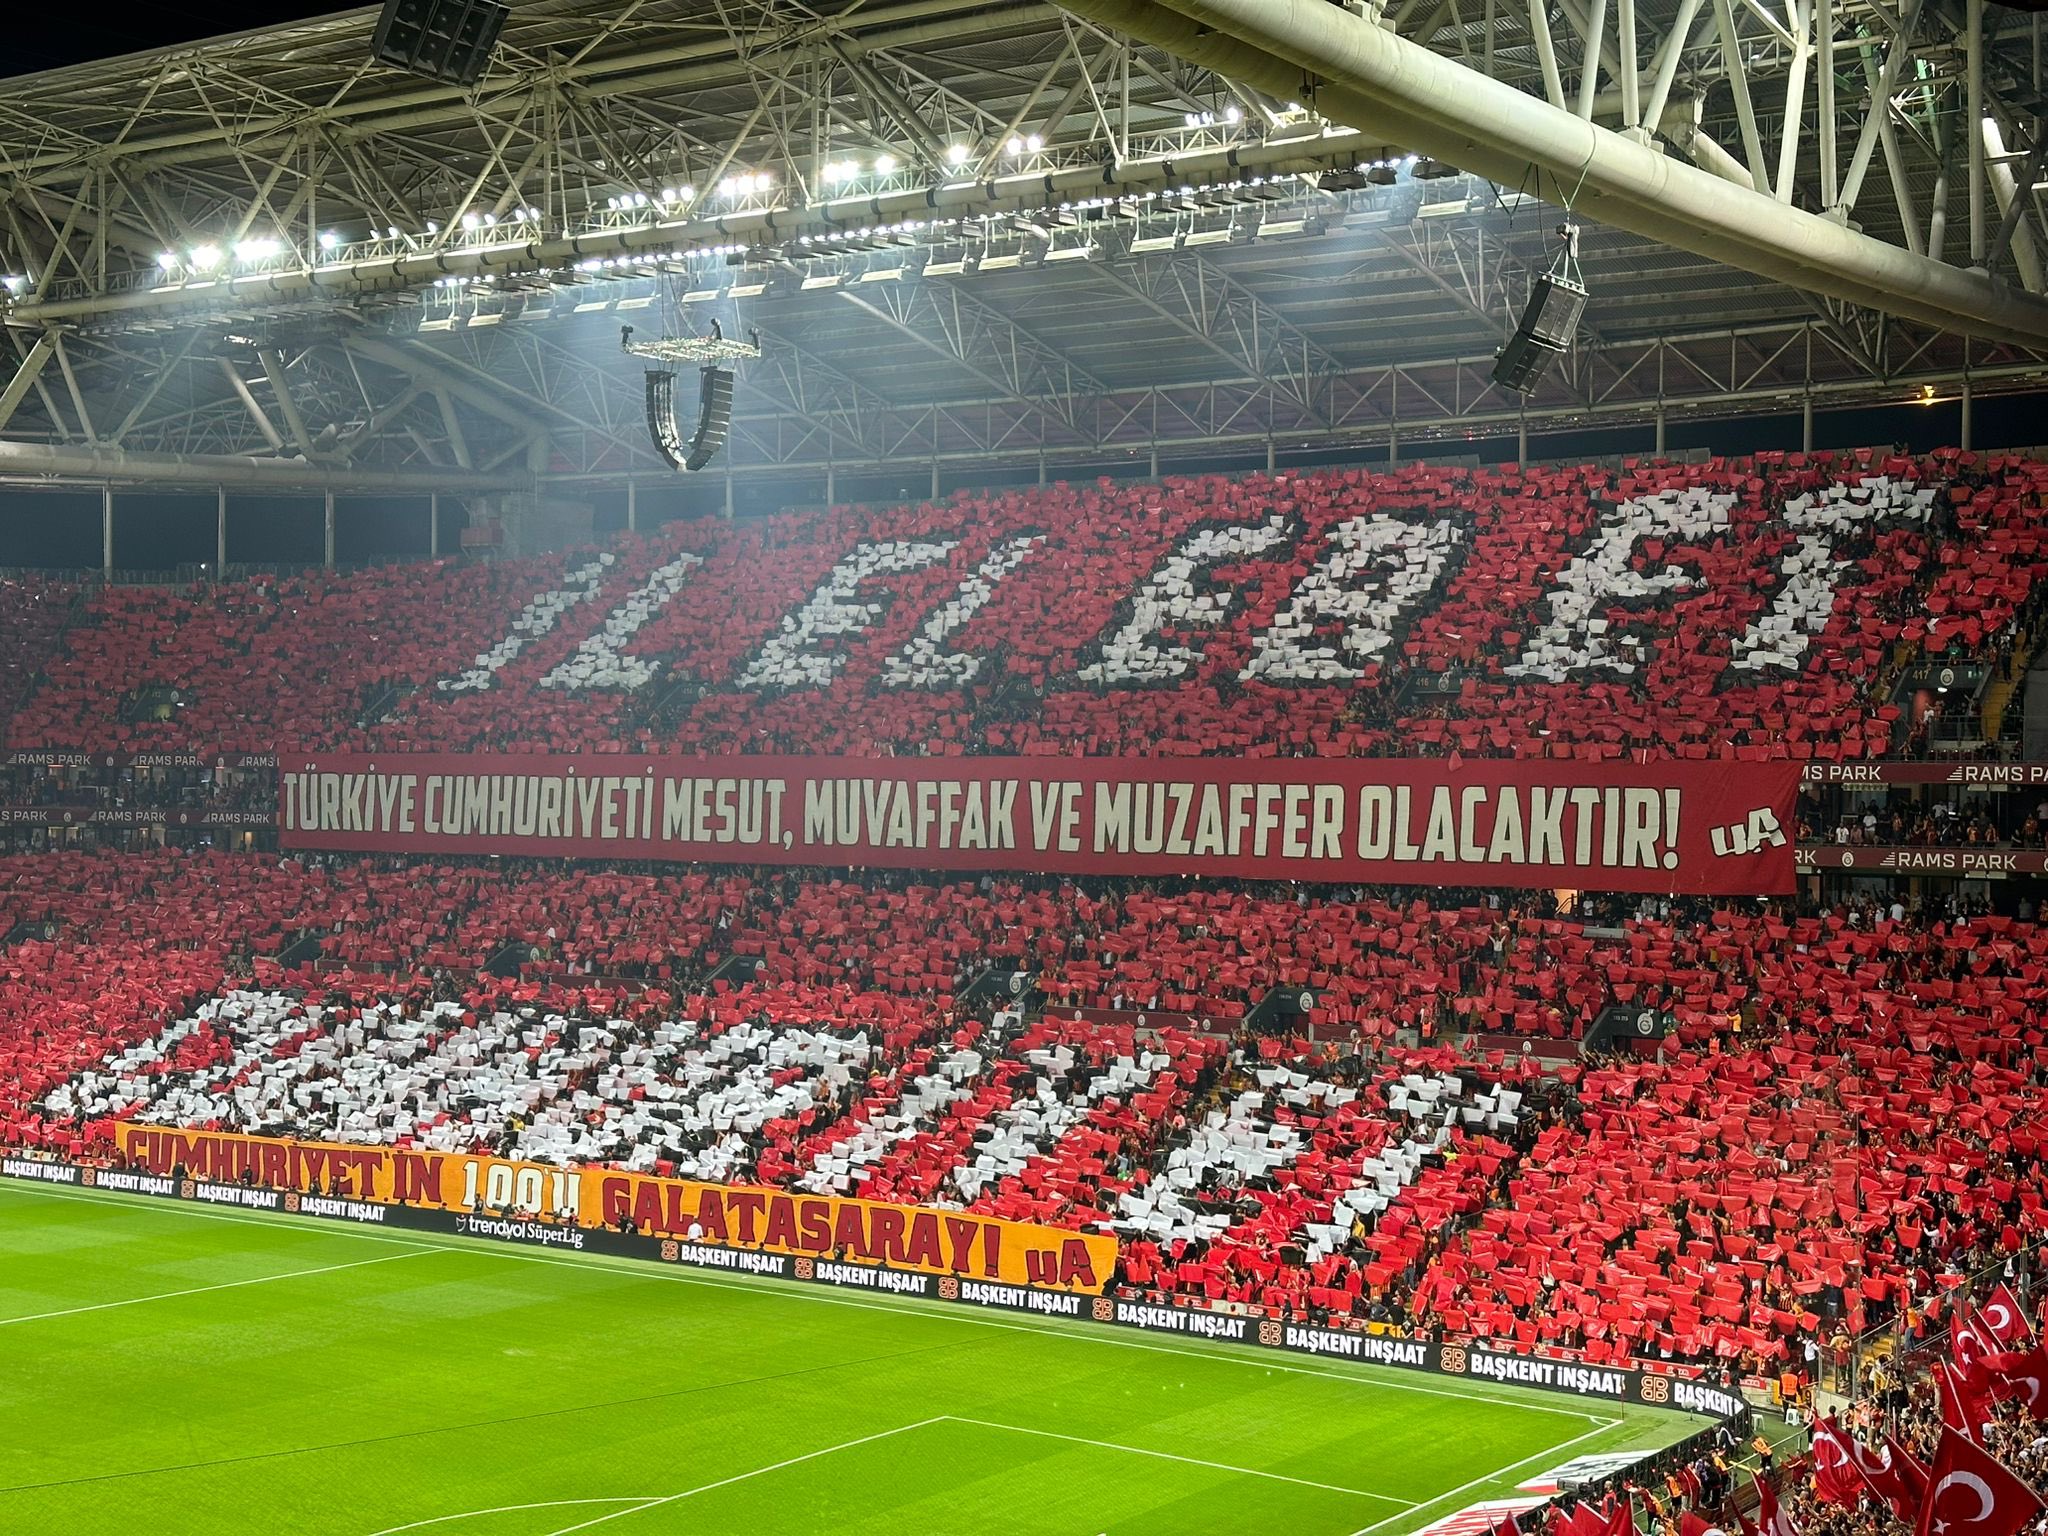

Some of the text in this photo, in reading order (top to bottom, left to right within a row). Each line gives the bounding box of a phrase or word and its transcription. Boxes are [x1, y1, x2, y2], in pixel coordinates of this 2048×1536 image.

[1913, 669, 1929, 680] 417
[18, 754, 91, 766] RAMS PARK
[139, 755, 172, 766] RAMS
[246, 756, 274, 767] RAMS
[1829, 765, 1881, 780] PARK
[1965, 766, 2024, 782] RAMS
[14, 811, 48, 822] PARK
[98, 811, 167, 823] RAMS PARK
[210, 813, 270, 824] RAMS PARK
[283, 762, 1682, 870] TÜRKİYE CUMHURİYETİ MESUT, MUVAFFAK VE MUZAFFER OLACAKTIR!
[1898, 852, 2017, 870] RAMS PARK
[3, 1159, 44, 1177] BAŞKENT
[96, 1171, 140, 1190] BAŞKENT
[196, 1184, 241, 1203] BAŞKENT
[301, 1196, 347, 1216] BAŞKENT
[468, 1215, 584, 1249] trendyol SüperLig
[603, 1177, 1000, 1278] GALATASARAY!
[681, 1244, 738, 1269] BAŞKENT
[816, 1262, 877, 1285] BAŞKENT
[961, 1281, 1026, 1306] BAŞKENT
[1117, 1303, 1188, 1329] BAŞKENT
[1286, 1326, 1362, 1353] BAŞKENT
[1470, 1353, 1554, 1381] BAŞKENT
